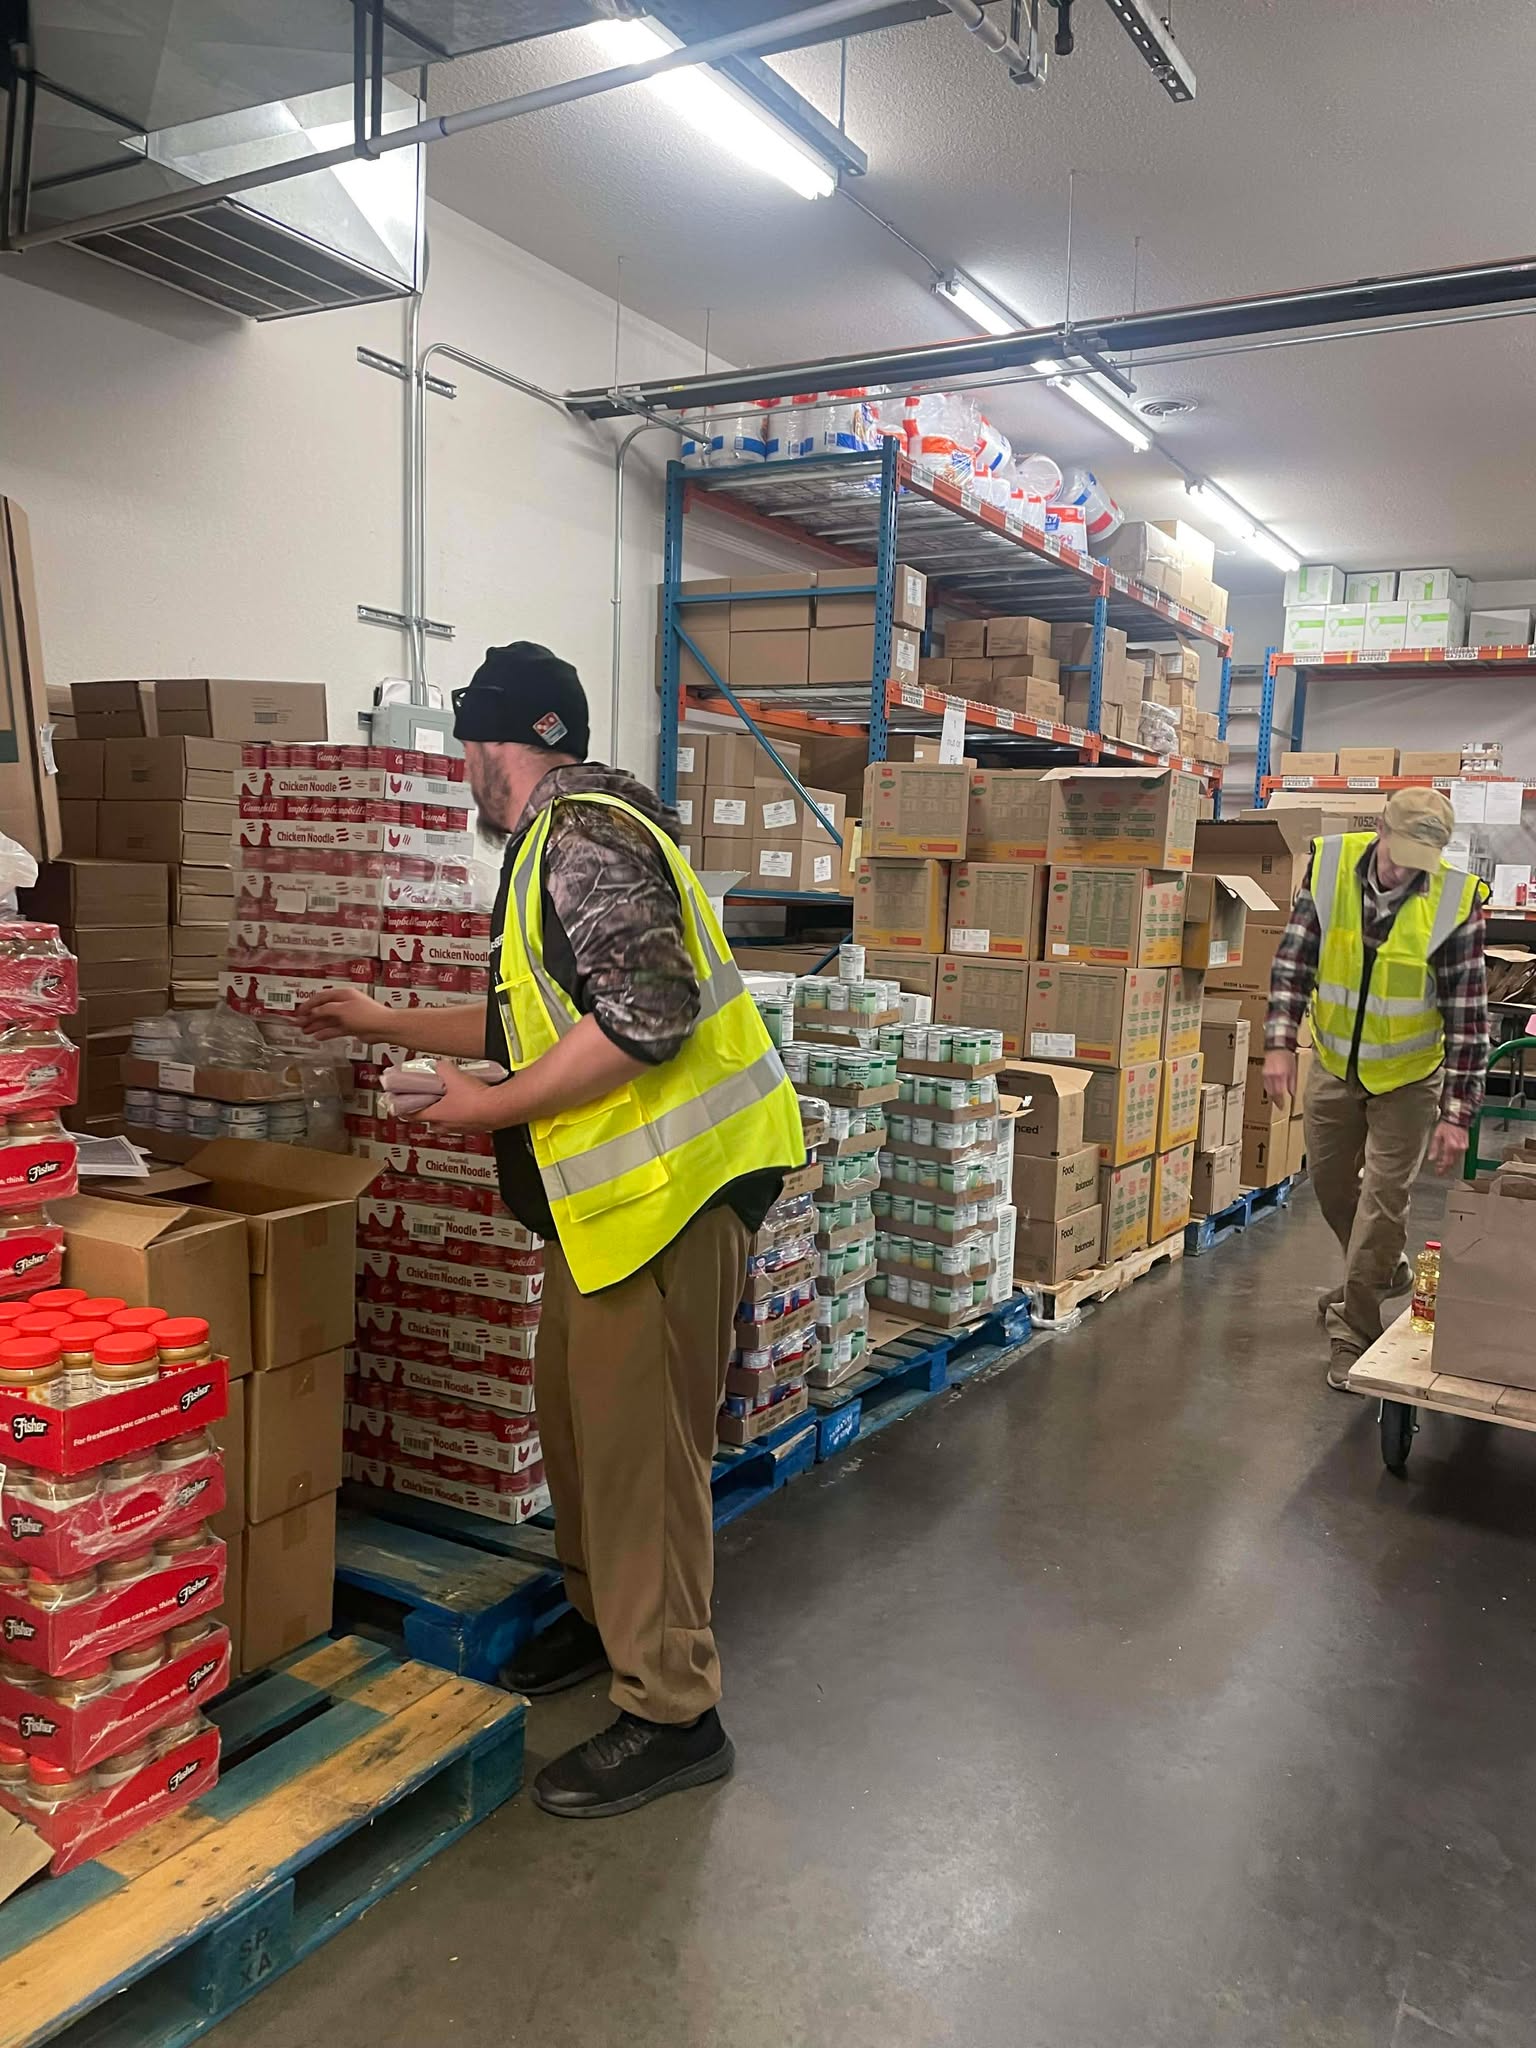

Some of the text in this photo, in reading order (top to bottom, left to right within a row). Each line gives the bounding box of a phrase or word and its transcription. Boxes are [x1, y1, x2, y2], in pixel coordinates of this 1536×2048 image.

[279, 781, 337, 792] Chicken Noodle
[276, 831, 335, 843] Chicken Noodle
[429, 948, 489, 961] Chicken Noodl
[28, 1163, 60, 1182] Fisher
[425, 1159, 491, 1179] Chicken Noodle
[1062, 1163, 1075, 1177] Food
[1075, 1176, 1094, 1193] Balanced
[445, 1221, 477, 1236] Noodle
[1060, 1225, 1074, 1241] Food
[1074, 1238, 1095, 1254] Balanced
[15, 1254, 46, 1274] Fisher
[406, 1266, 441, 1281] Chicken
[441, 1271, 472, 1287] Noodle
[407, 1322, 443, 1337] Chicken
[409, 1372, 445, 1388] Chicken
[445, 1380, 474, 1395] Noodle
[73, 1437, 86, 1447] For
[86, 1425, 120, 1442] freshness
[120, 1421, 134, 1432] you
[133, 1417, 146, 1426] can
[160, 1405, 178, 1416] think
[181, 1383, 210, 1410] Fisher
[14, 1417, 48, 1440] Fisher
[433, 1436, 463, 1453] Noodle
[178, 1478, 209, 1506] Fisher
[401, 1478, 464, 1505] Chicken Noodle
[11, 1516, 42, 1538] Fisher
[130, 1612, 144, 1622] can
[159, 1597, 177, 1609] think
[178, 1576, 209, 1604] Fisher
[5, 1618, 35, 1640] Fisher
[188, 1661, 216, 1691] Fisher
[21, 1716, 55, 1737] Fisher
[170, 1761, 198, 1791] Fisher
